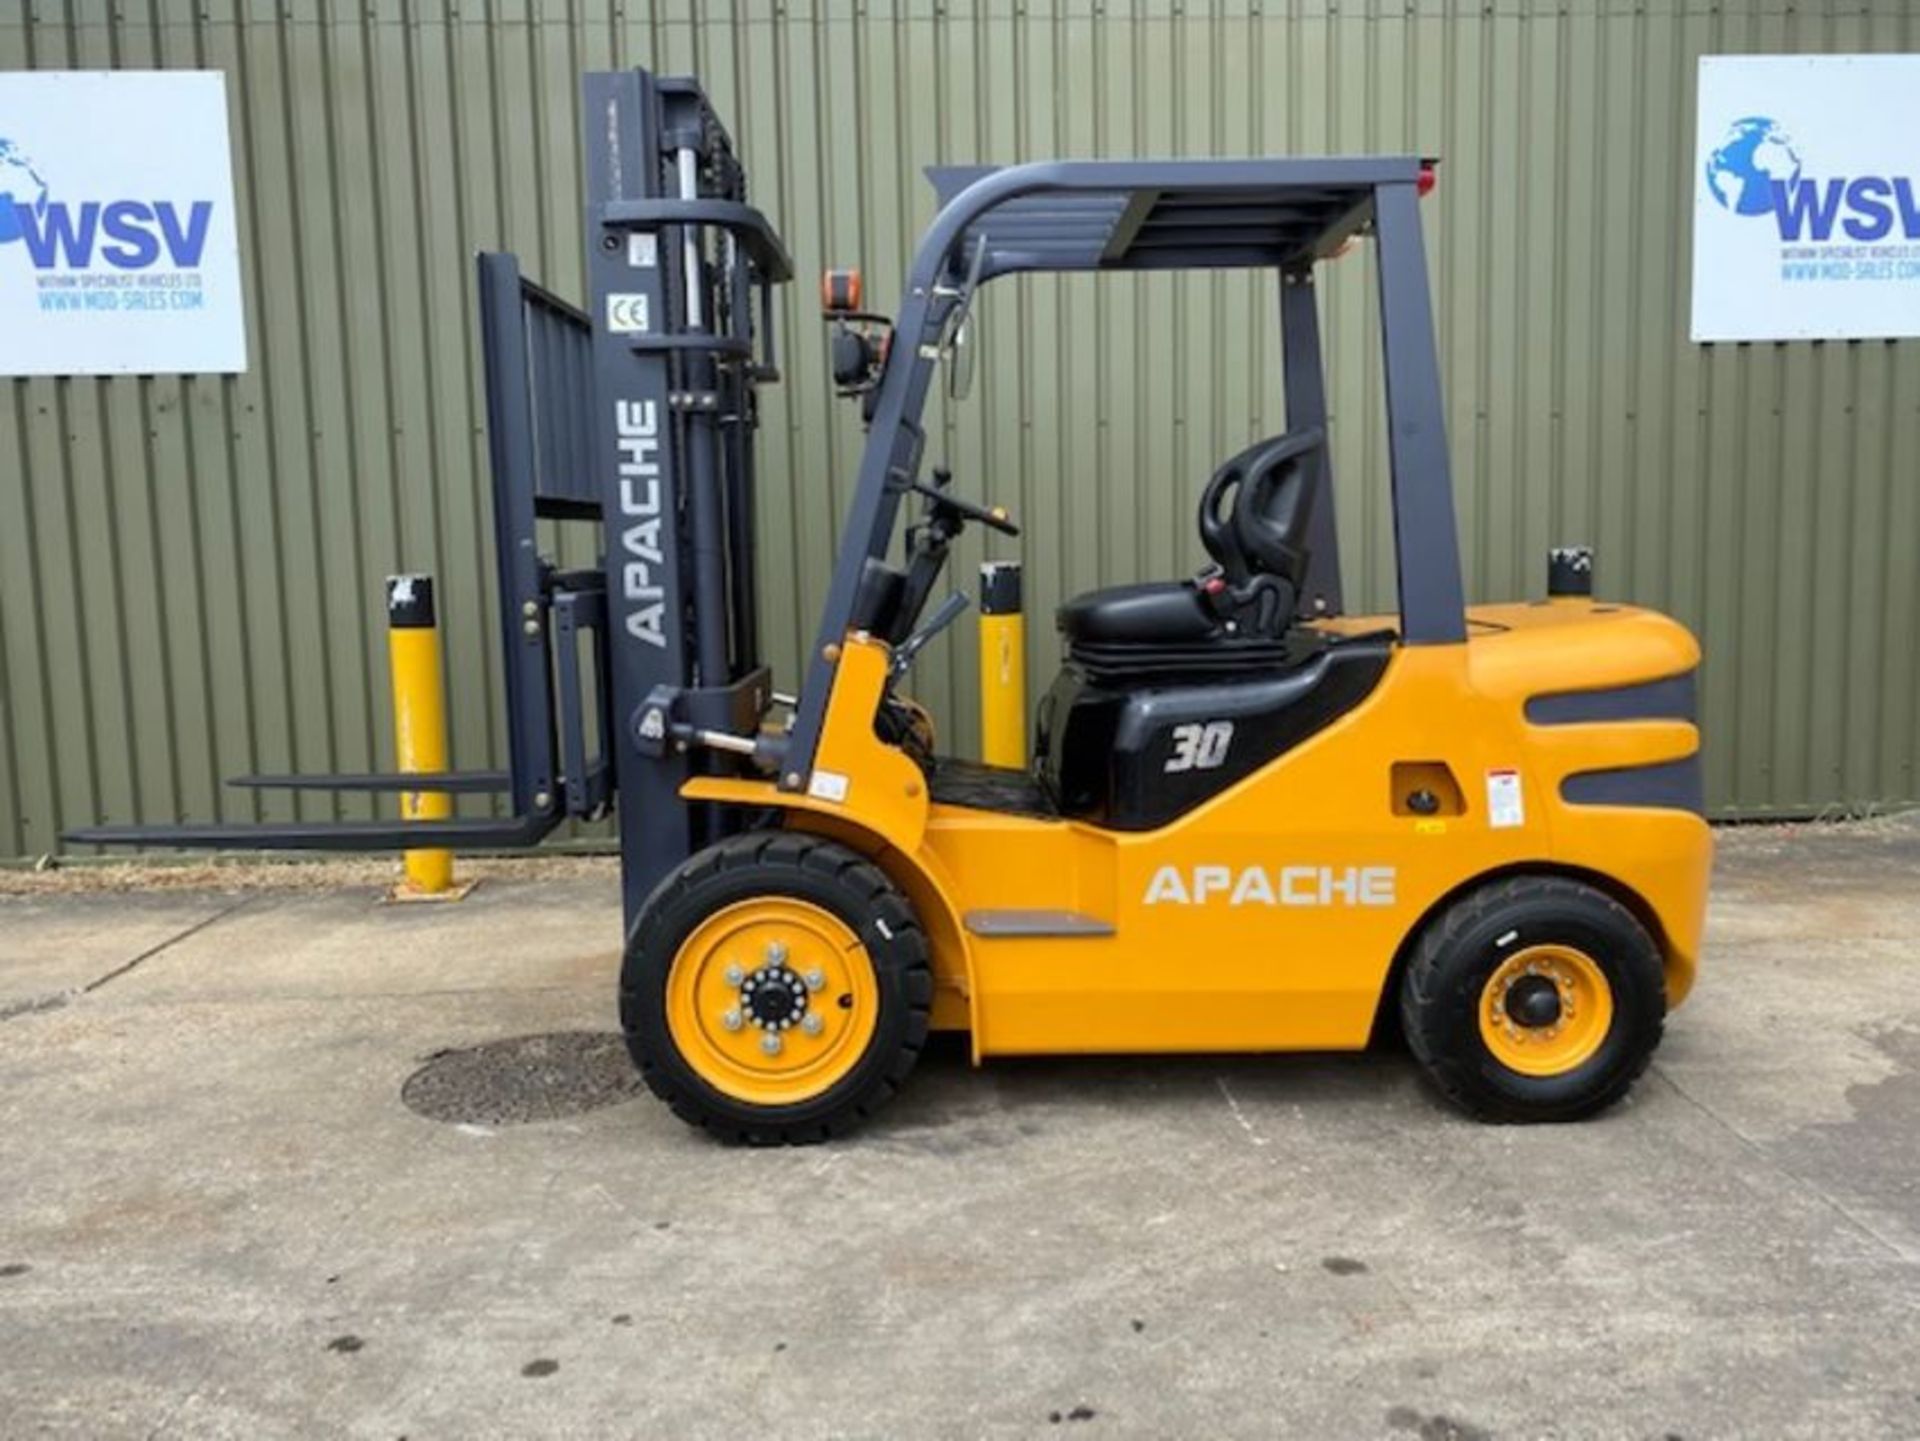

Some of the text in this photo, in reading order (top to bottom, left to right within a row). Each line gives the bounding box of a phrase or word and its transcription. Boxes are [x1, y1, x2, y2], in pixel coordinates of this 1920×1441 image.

[15, 201, 213, 269] WSV
[1820, 246, 1867, 259] SPECIALIST
[81, 274, 133, 288] SPECIALIST
[137, 274, 183, 288] VEHICLES
[616, 399, 667, 648] APACHE
[1164, 720, 1235, 773] 30
[1145, 865, 1397, 906] APACHE
